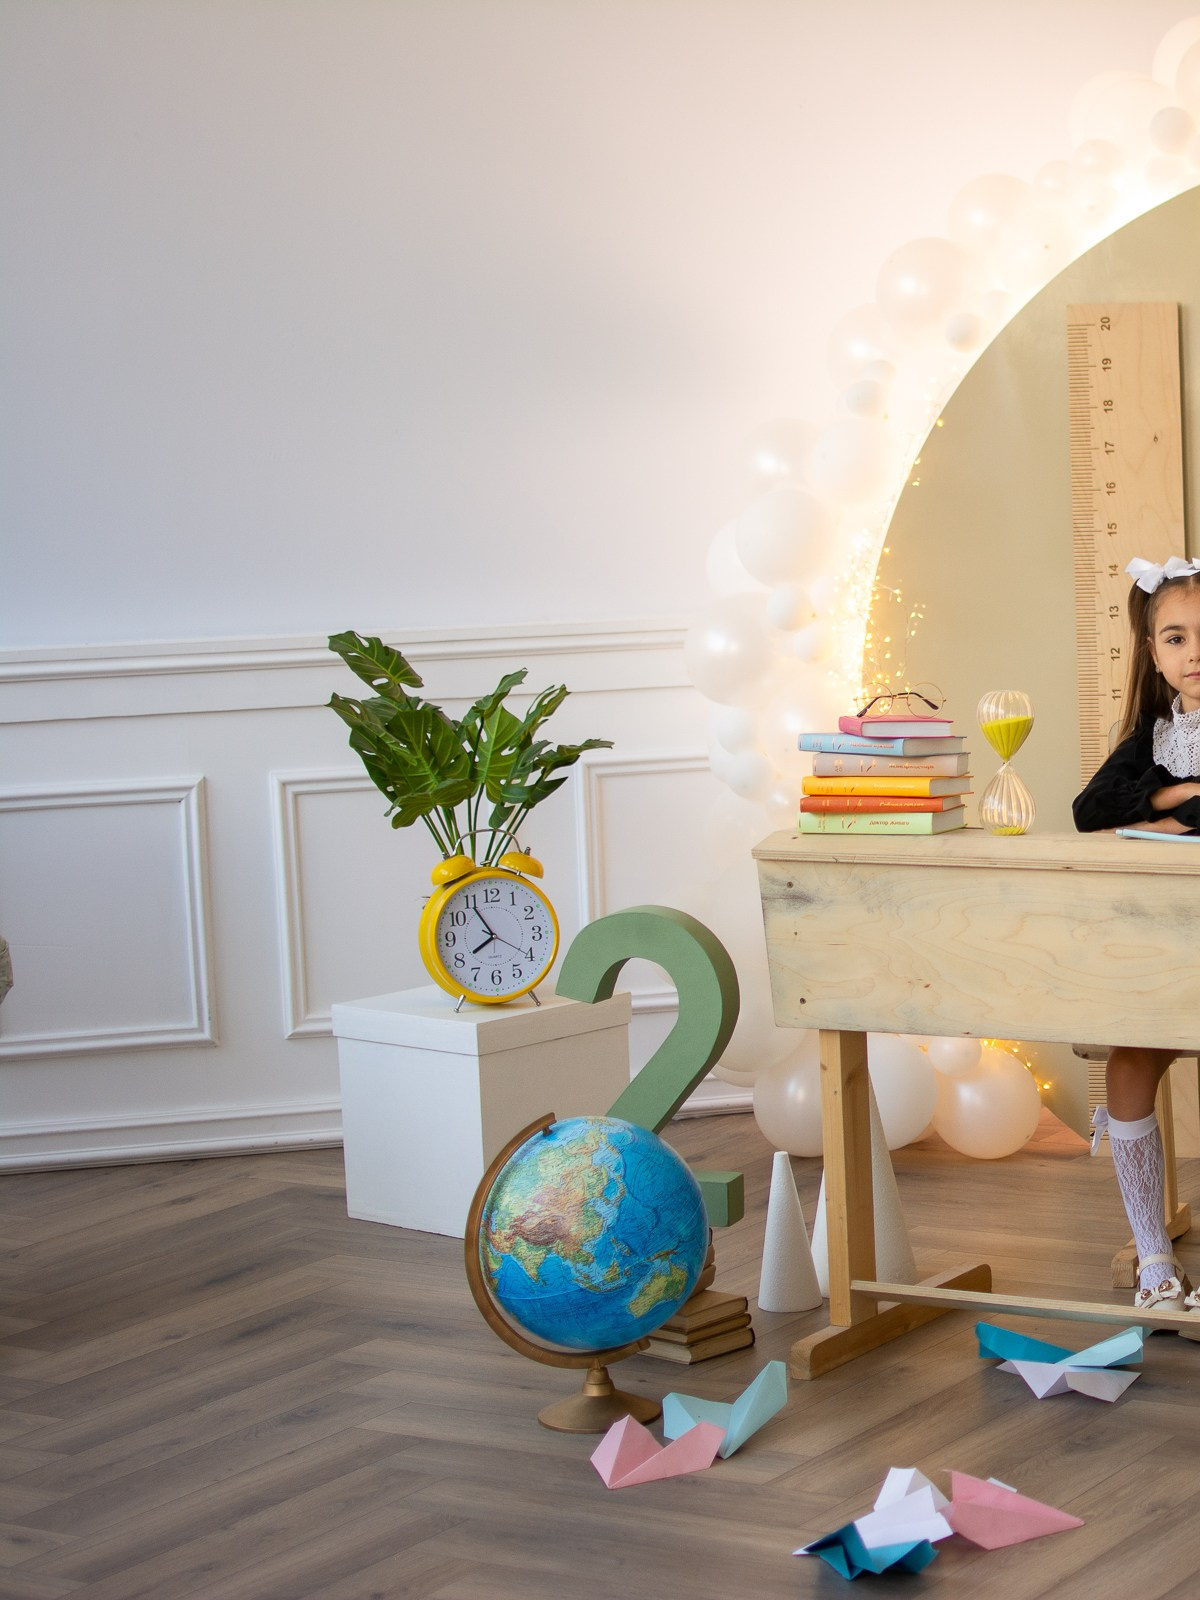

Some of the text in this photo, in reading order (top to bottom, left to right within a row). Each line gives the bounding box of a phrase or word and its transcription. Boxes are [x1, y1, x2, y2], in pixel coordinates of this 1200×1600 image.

[1100, 316, 1111, 332] 20
[1102, 357, 1112, 373] 19
[1103, 399, 1114, 414] 18
[1104, 441, 1115, 455] 17
[1106, 481, 1116, 496] 16
[1107, 522, 1118, 538] 15
[1109, 563, 1119, 579] 14
[1109, 605, 1119, 620] 13
[1110, 647, 1121, 662] 12
[1112, 688, 1122, 701] 11
[464, 894, 479, 909] 11
[483, 888, 501, 903] 12
[509, 891, 516, 906] 1
[449, 911, 466, 927] 10
[523, 905, 535, 920] 2
[445, 931, 456, 947] 9
[531, 926, 543, 941] 3
[454, 953, 465, 968] 8
[525, 947, 535, 962] 4
[471, 967, 481, 982] 7
[491, 970, 502, 985] 6
[512, 964, 523, 979] 5
[555, 904, 744, 1227] 2
